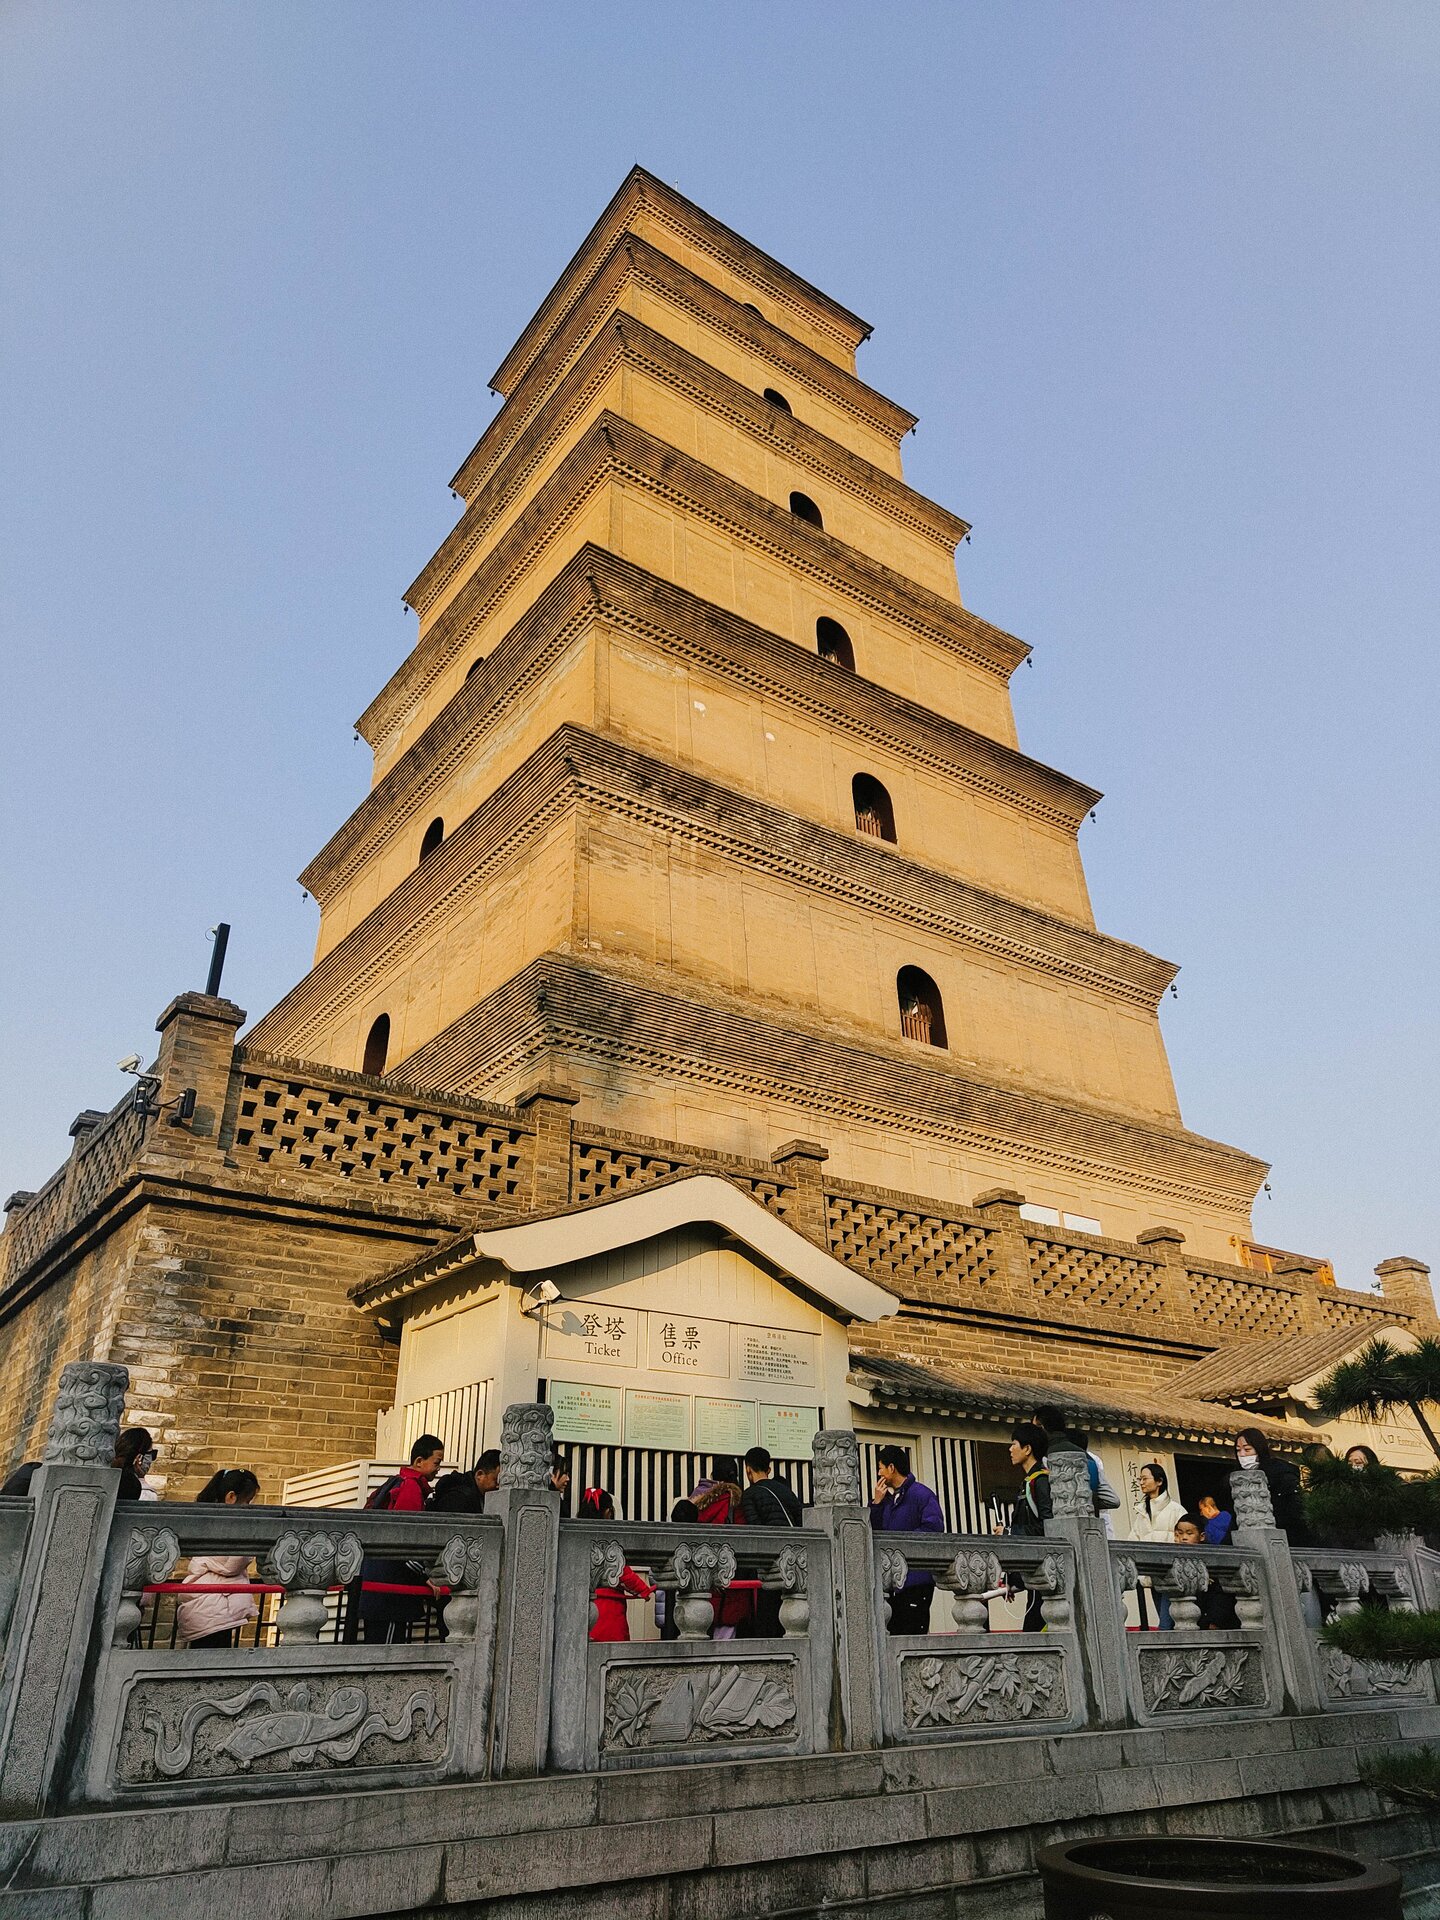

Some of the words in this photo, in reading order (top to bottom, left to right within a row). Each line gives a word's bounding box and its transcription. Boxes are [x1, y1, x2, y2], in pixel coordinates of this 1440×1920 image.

[580, 1313, 626, 1341] 登塔
[661, 1322, 701, 1350] 售票
[585, 1342, 620, 1357] Ticket
[662, 1351, 698, 1366] Office
